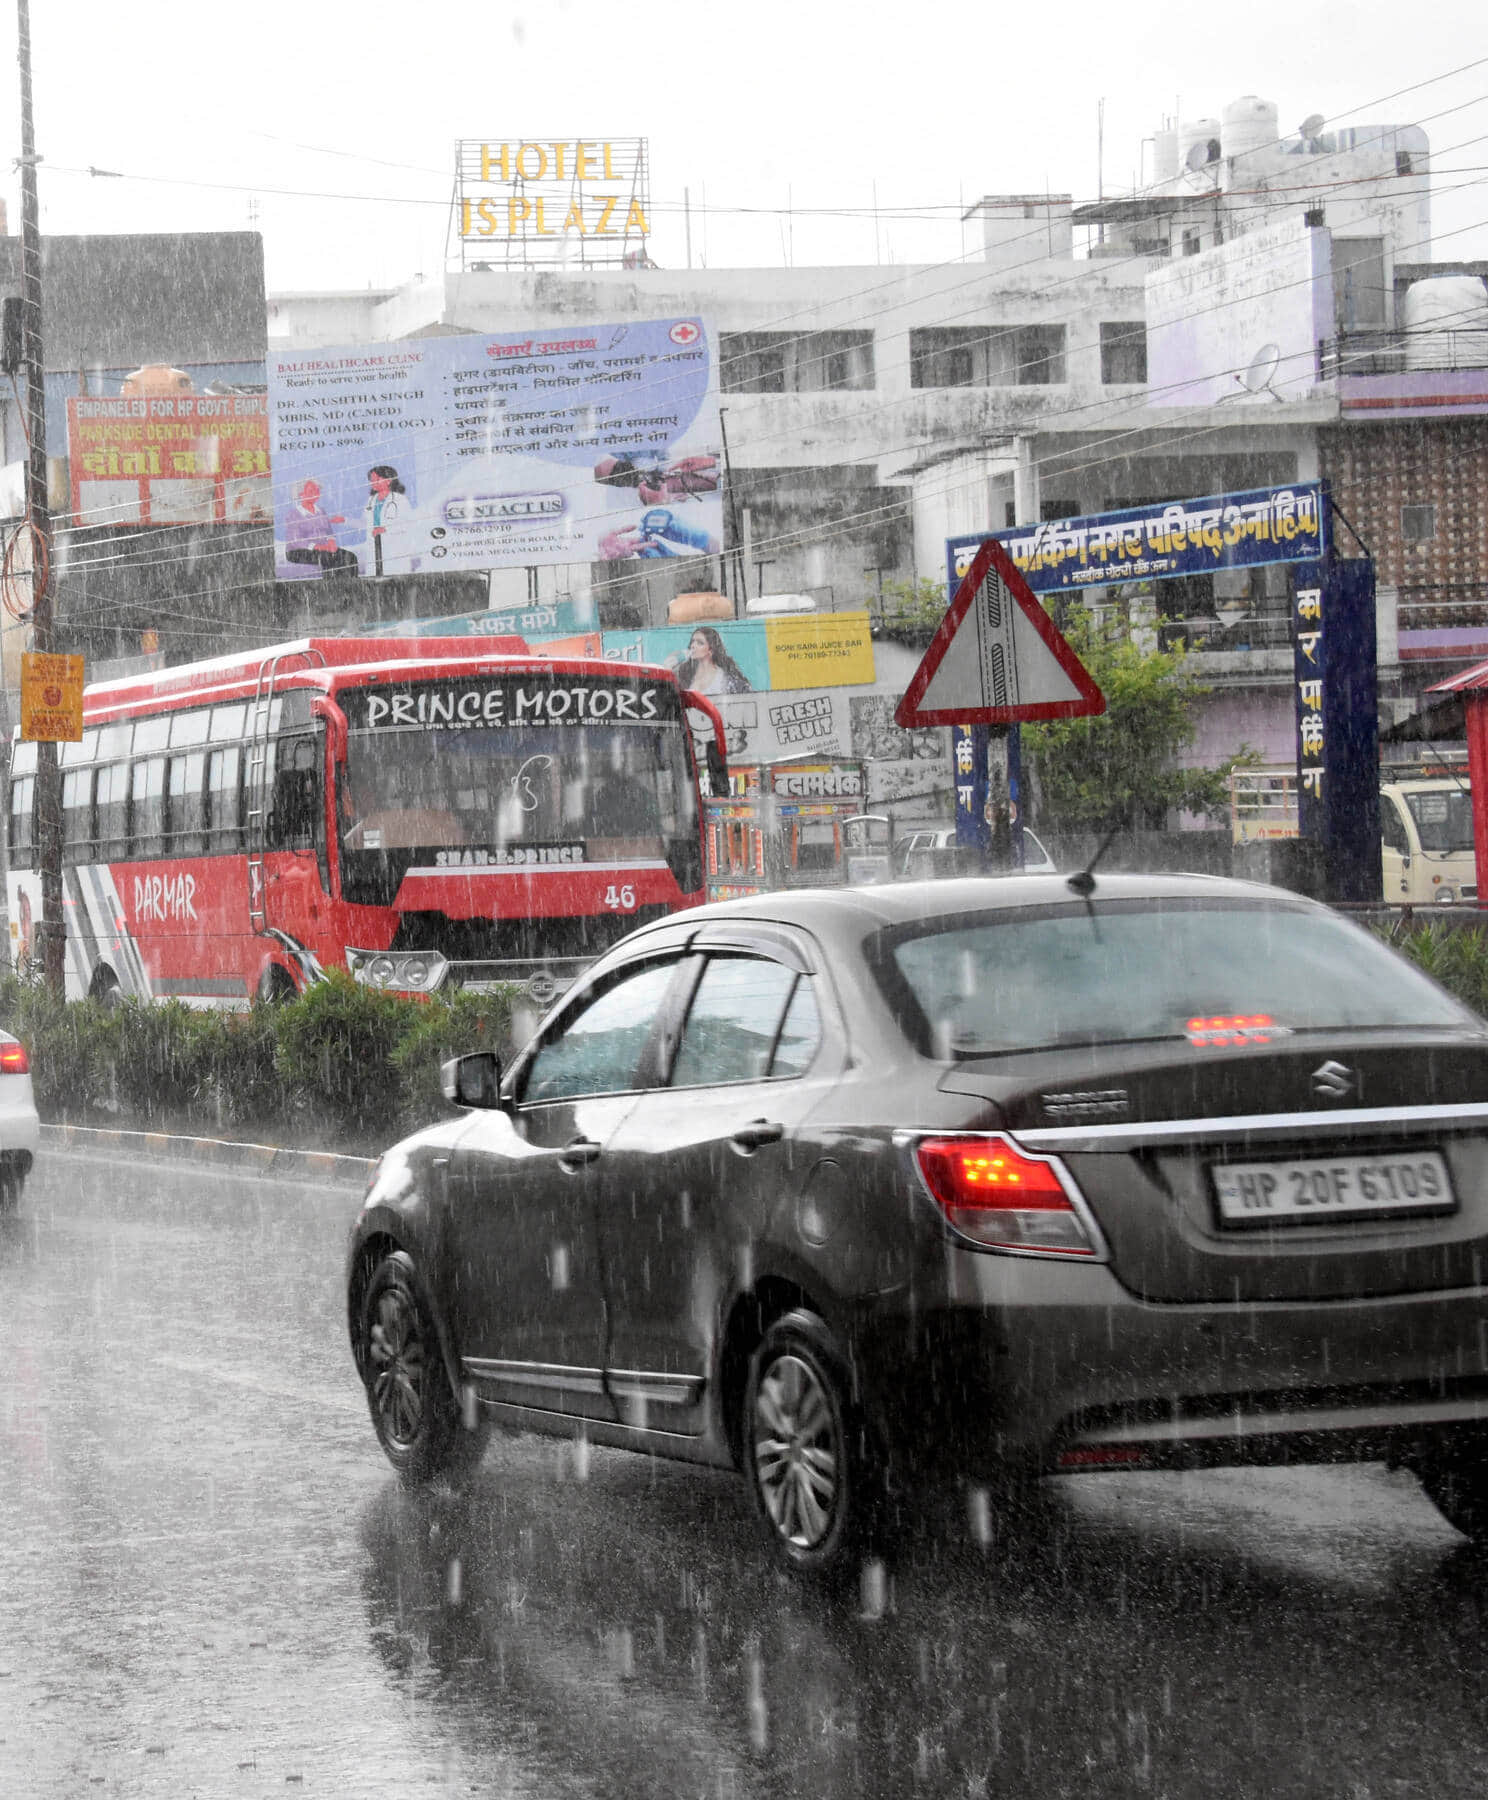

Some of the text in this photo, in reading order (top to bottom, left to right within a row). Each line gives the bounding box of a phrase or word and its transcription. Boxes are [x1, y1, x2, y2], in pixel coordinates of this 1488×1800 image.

[480, 142, 624, 181] HOTEL
[308, 354, 385, 371] HEALTHCARE
[318, 376, 328, 386] to
[330, 375, 353, 385] serve
[355, 374, 377, 386] your
[378, 370, 408, 382] health
[76, 401, 147, 418] EMPANELED
[150, 401, 176, 417] FOR
[277, 400, 299, 410] DR.
[380, 390, 424, 401] SINGH
[322, 410, 344, 421] MD
[146, 422, 197, 441] DENTAL
[201, 421, 263, 440] HOSPITAL
[278, 425, 319, 438] CCDM
[279, 440, 307, 451] REG
[539, 499, 562, 513] US
[1011, 522, 1089, 571] पार्किंग
[1088, 519, 1143, 562] नगर
[1144, 505, 1223, 557] परिषद्
[1222, 497, 1271, 547] ऊना
[820, 640, 844, 650] JUICE
[845, 639, 862, 648] BAR
[367, 688, 658, 728] PRINCE MOTORS
[768, 696, 833, 727] FRESH
[776, 716, 834, 746] FRUIT
[134, 871, 199, 924] PARMAR
[603, 885, 636, 909] 46
[1237, 1172, 1276, 1209] HP
